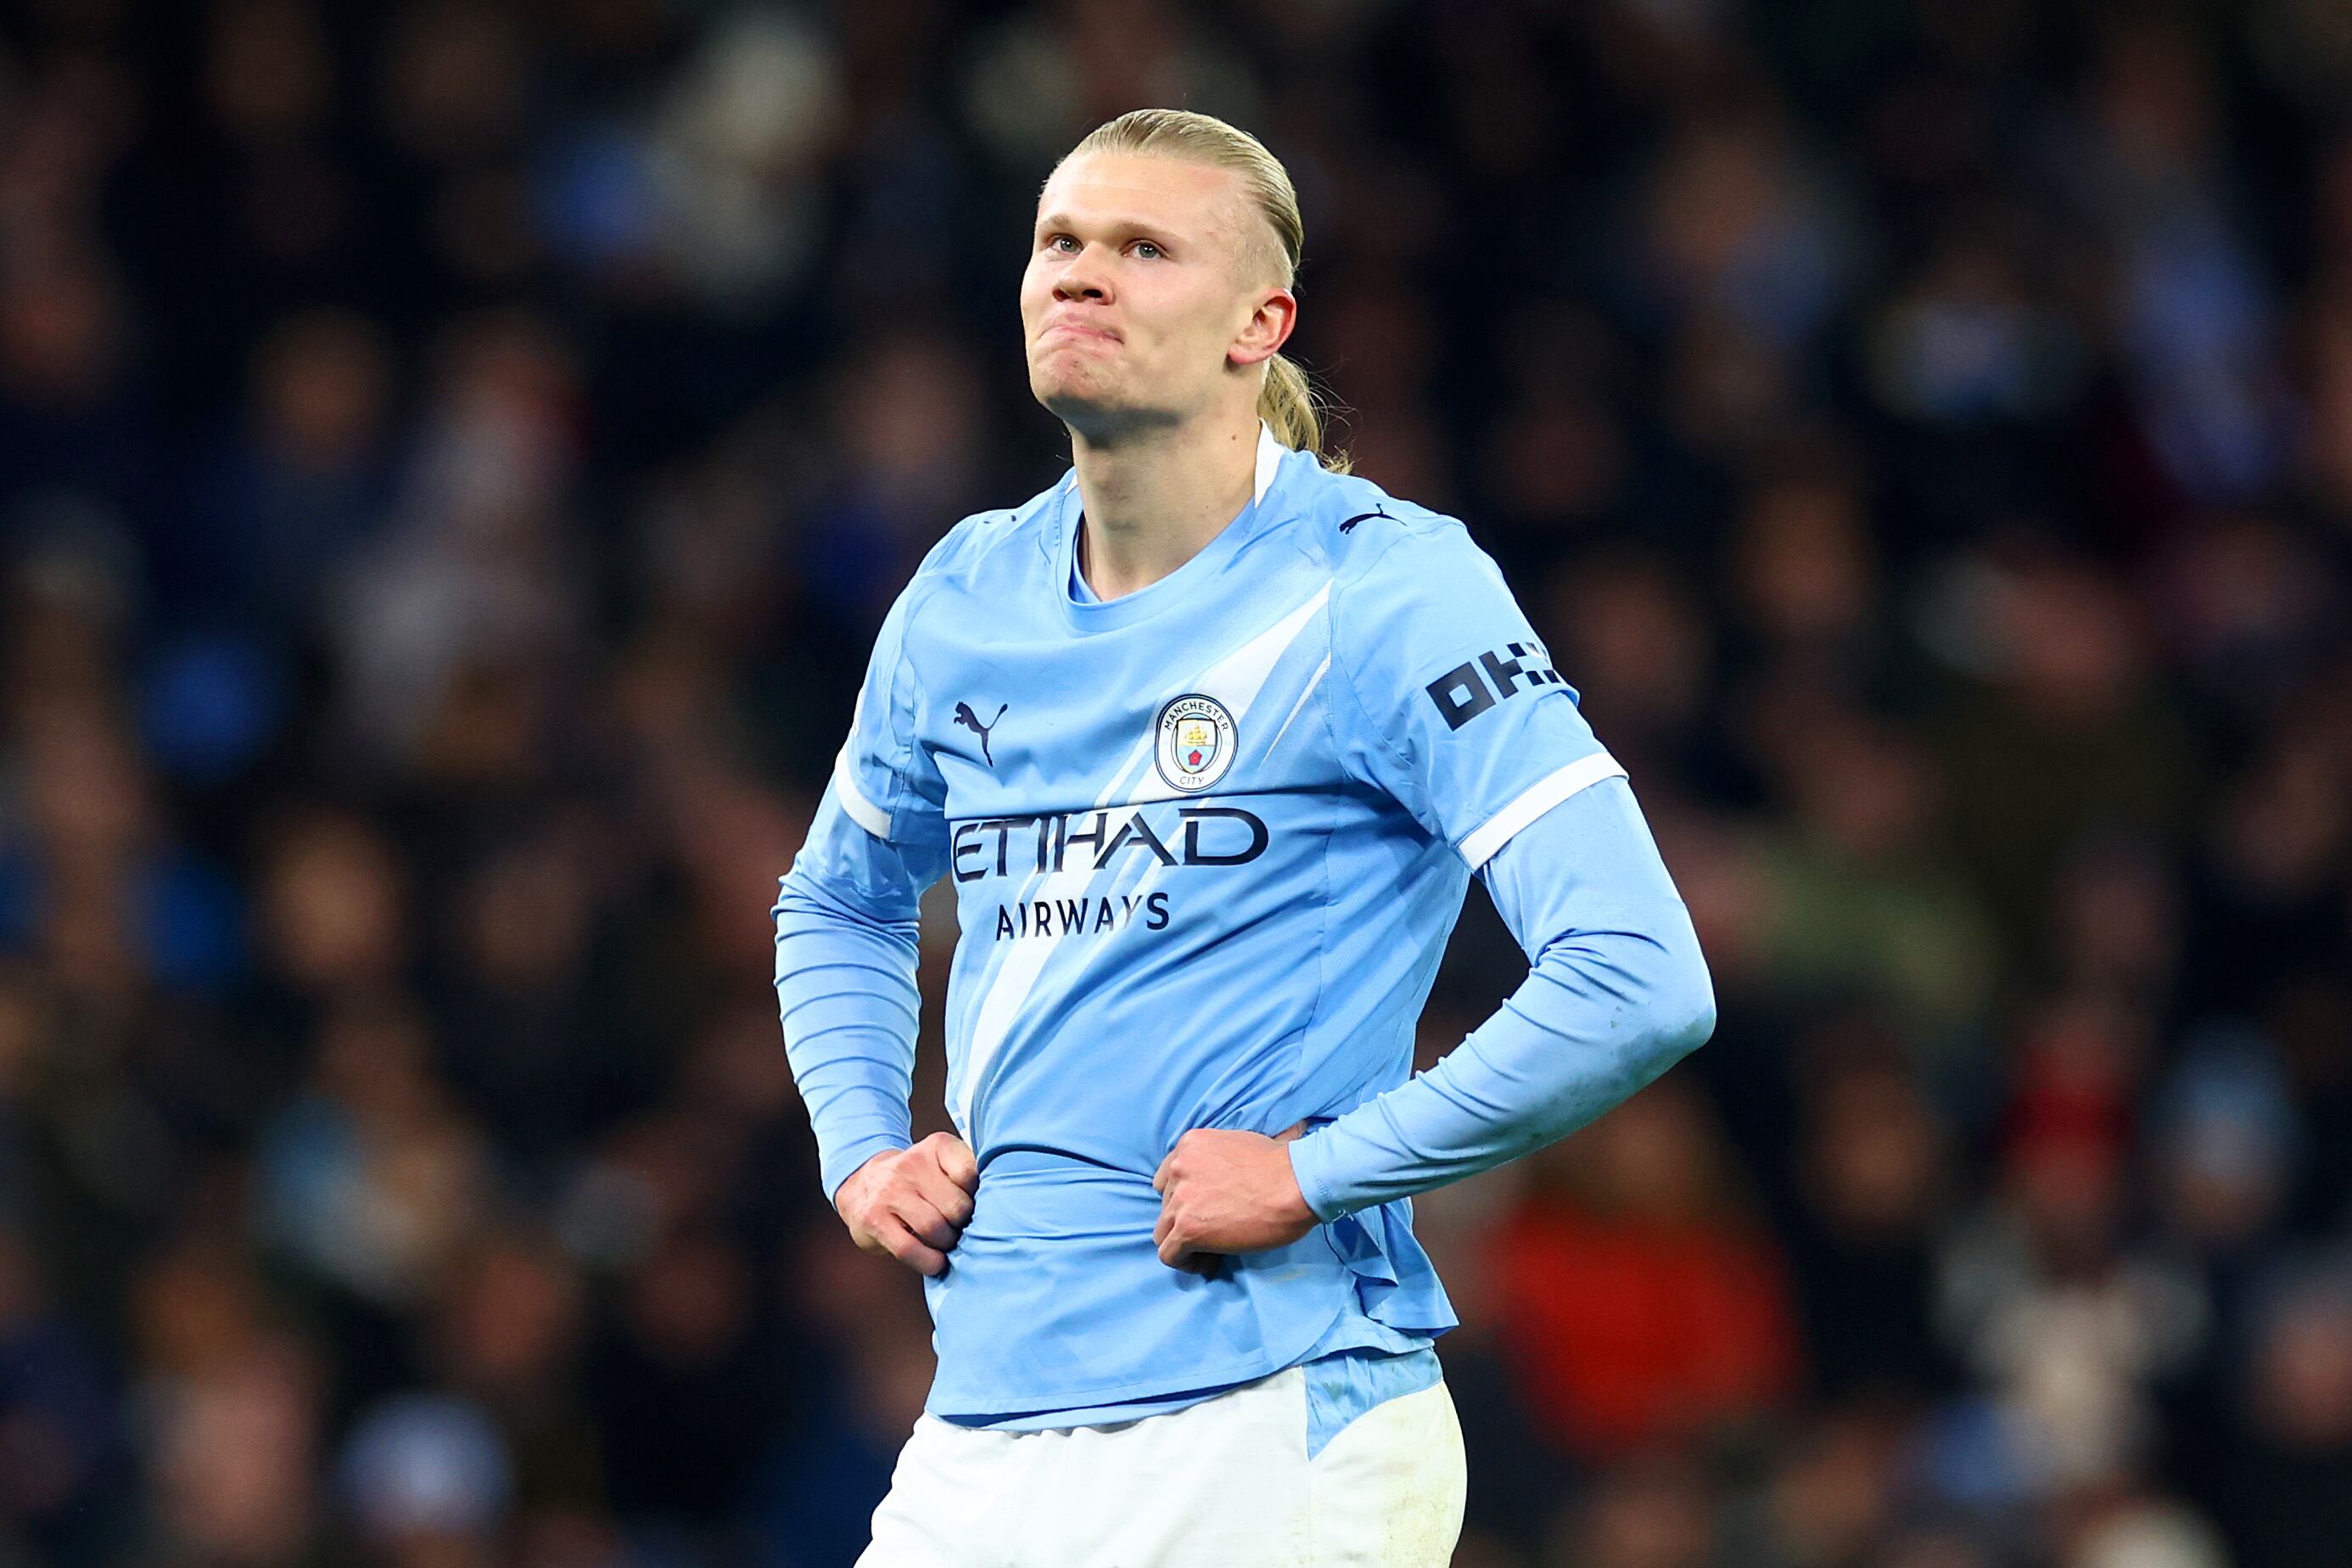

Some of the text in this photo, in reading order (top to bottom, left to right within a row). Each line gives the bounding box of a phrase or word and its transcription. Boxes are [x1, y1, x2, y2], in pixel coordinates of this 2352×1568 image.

[1164, 702, 1229, 731] MANCHESTER
[1179, 776, 1204, 785] CITY
[953, 807, 1269, 883] ETIHAD
[995, 892, 1170, 941] AIRWAYS
